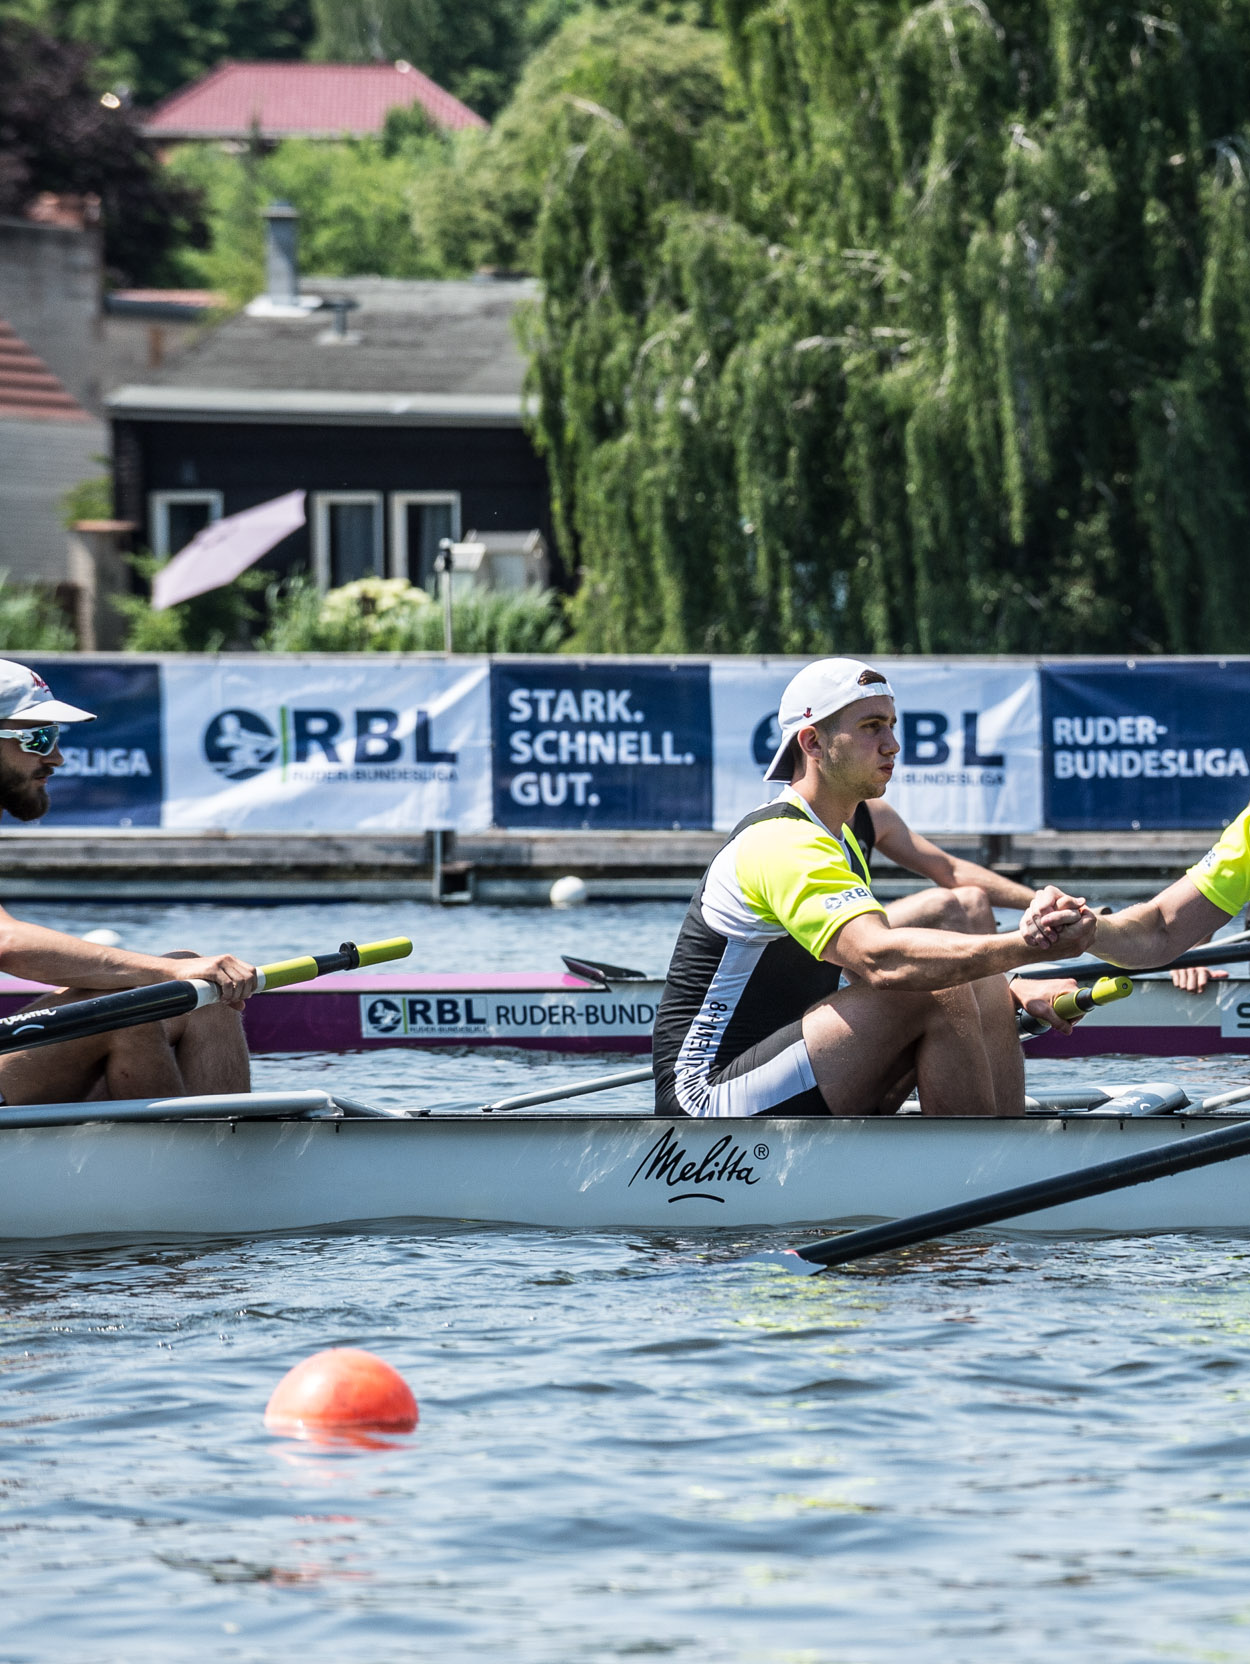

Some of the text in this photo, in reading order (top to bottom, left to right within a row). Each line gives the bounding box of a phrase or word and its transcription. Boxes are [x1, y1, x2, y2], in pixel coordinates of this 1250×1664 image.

[508, 688, 645, 723] STARK.
[293, 709, 458, 764] RBL
[902, 711, 1005, 766] BL
[1052, 716, 1169, 745] RUDER-
[55, 747, 152, 777] SLIGA
[509, 730, 695, 765] SCHNELL.
[1054, 748, 1250, 779] BUNDESLIGA
[510, 771, 601, 807] GUT.
[408, 999, 486, 1025] RBL
[496, 1004, 659, 1026] RUDER-BUND
